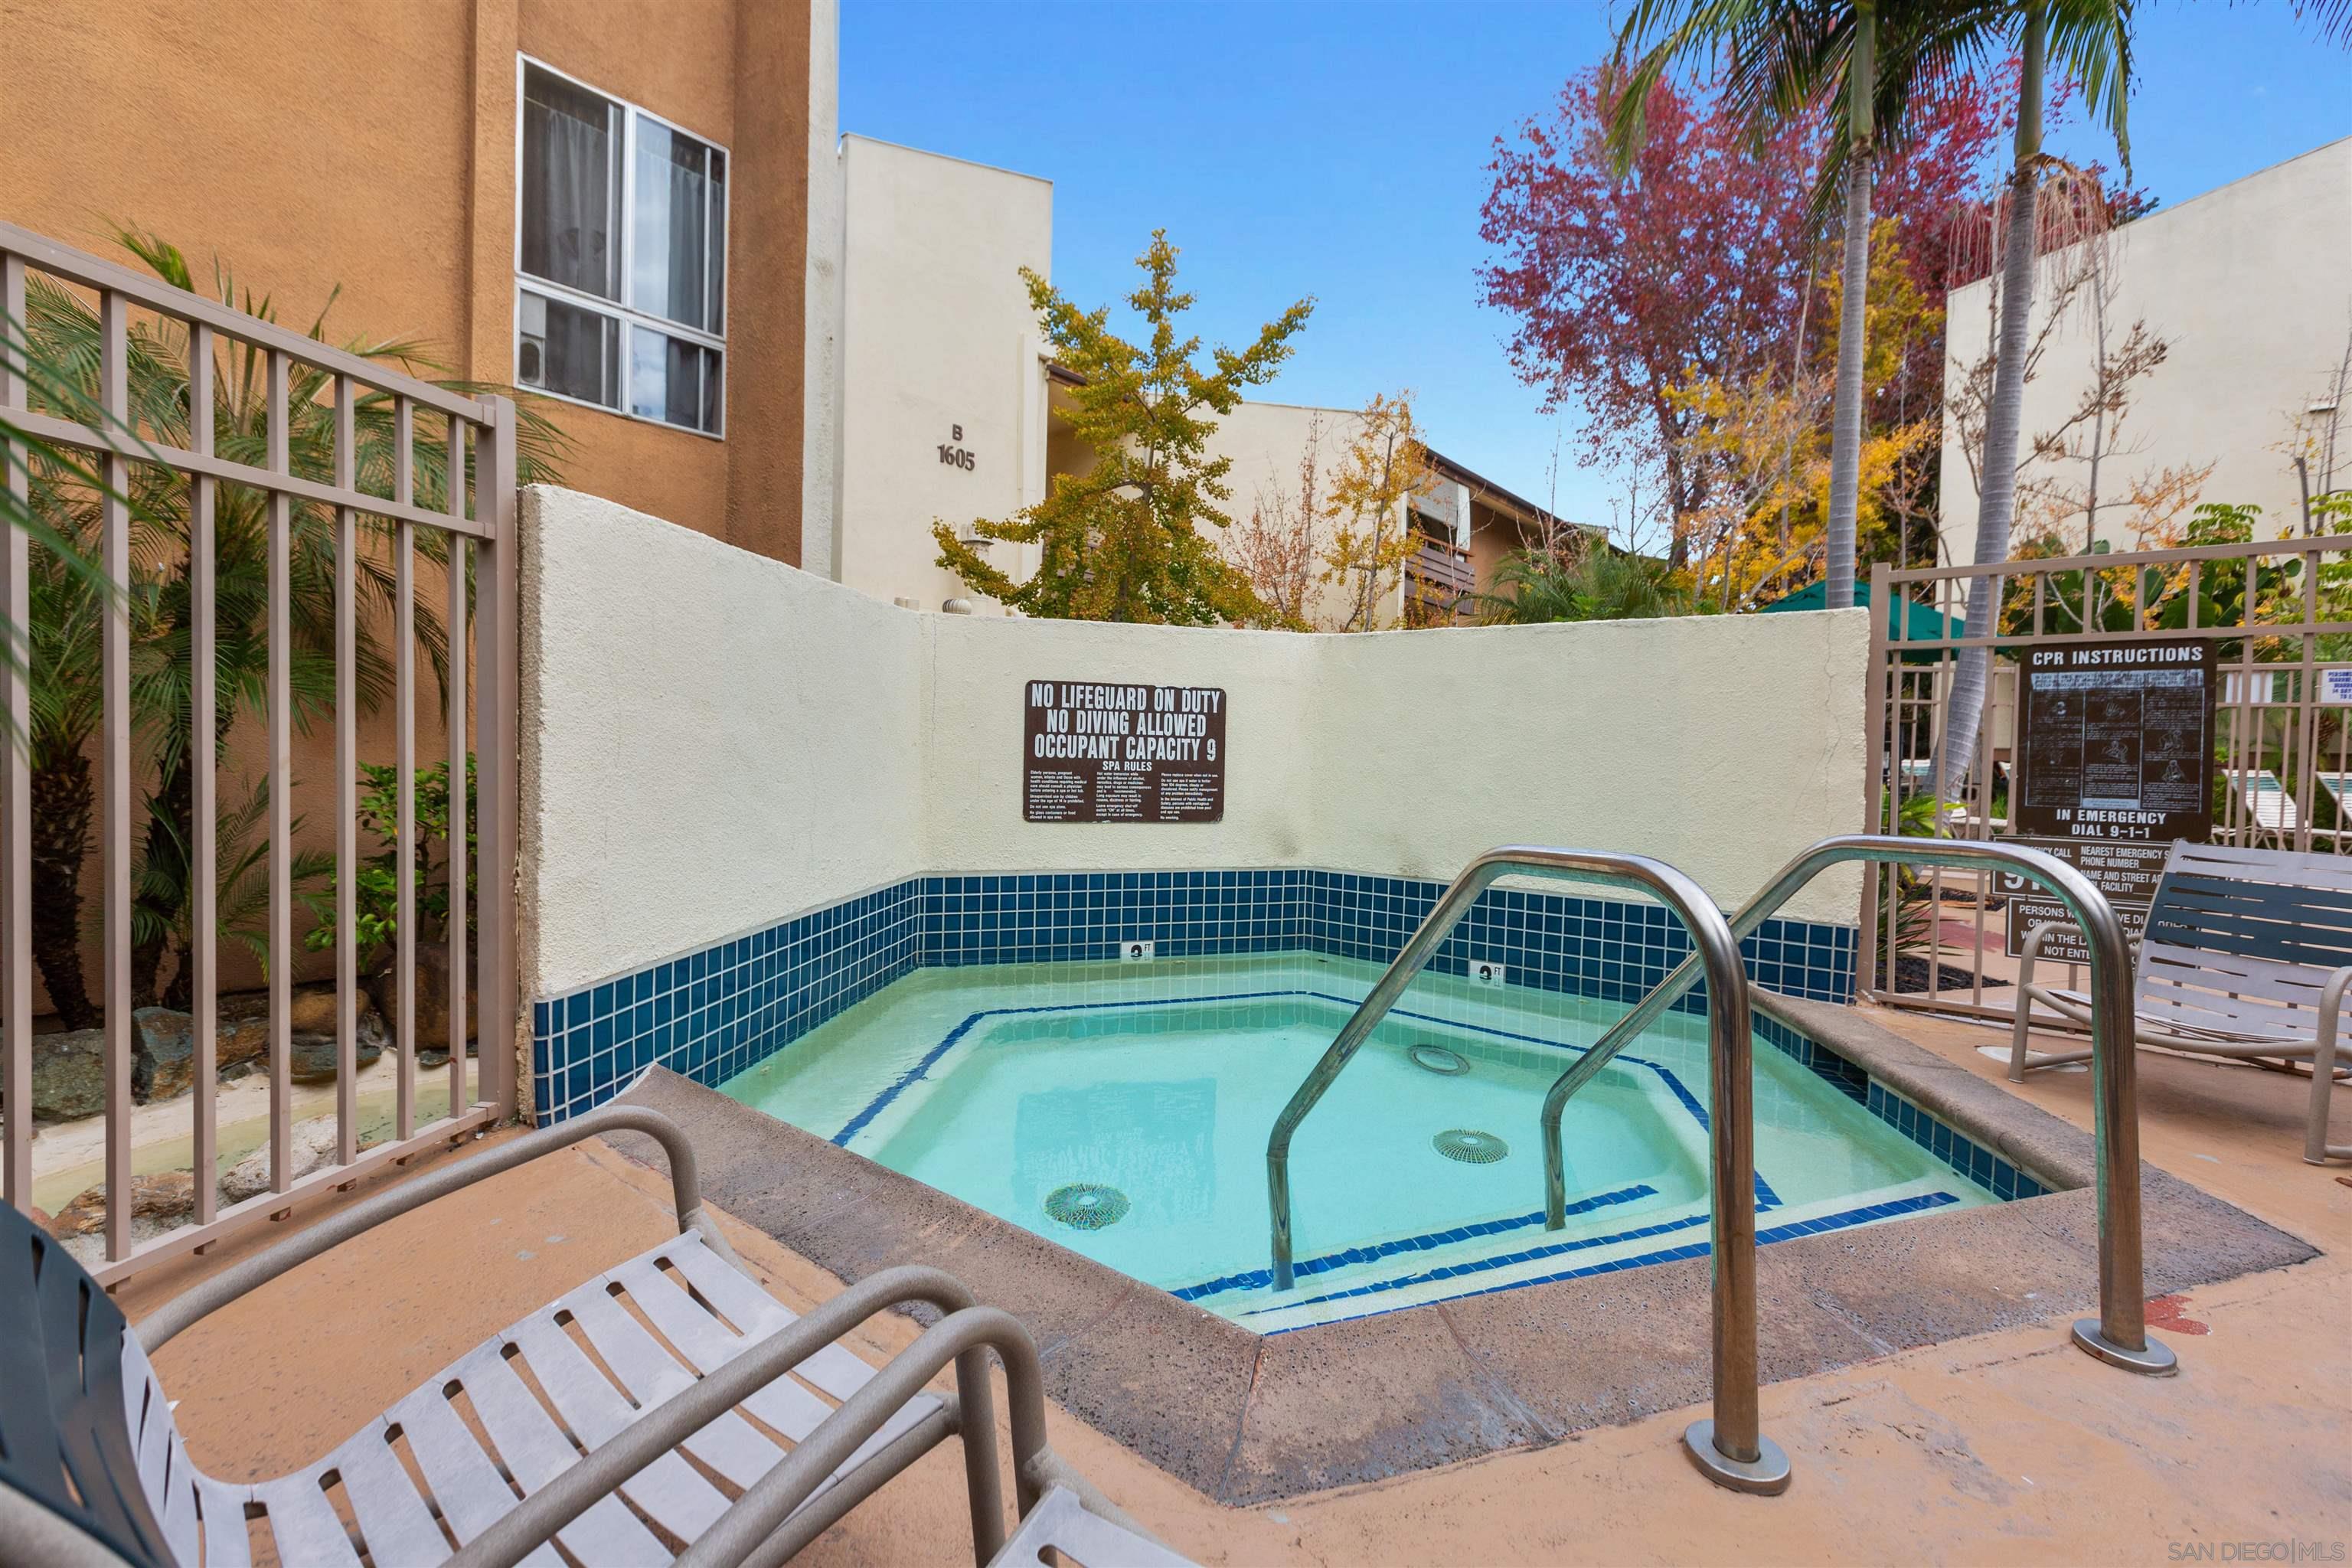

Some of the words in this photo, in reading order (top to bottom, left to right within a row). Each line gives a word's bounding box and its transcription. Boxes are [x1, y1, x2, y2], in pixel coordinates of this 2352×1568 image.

[952, 424, 963, 441] B
[937, 443, 975, 471] 1605
[2033, 652, 2064, 665] CPR
[2073, 646, 2203, 664] INSTRUCTIONS
[1031, 683, 1054, 707] NO
[1062, 684, 1147, 710] LIFEGUARD
[1154, 688, 1174, 712] ON
[1181, 690, 1220, 714] DUTY
[1047, 709, 1069, 733] NO
[1076, 710, 1129, 735] DIVING
[1136, 713, 1207, 737] ALLOWED
[1034, 733, 1120, 760] OCCUPANT
[1125, 737, 1200, 761] CAPACITY
[1207, 738, 1216, 762] 9
[1102, 761, 1120, 771] SPA
[1124, 761, 1152, 772] RULES
[2056, 808, 2070, 821] IN
[2078, 810, 2166, 825] EMERGENCY
[2072, 825, 2103, 836] DIAL
[2110, 825, 2150, 839] 9-1-1
[2054, 848, 2072, 858] CALL
[2081, 846, 2114, 856] NEAREST
[2116, 848, 2162, 859] EMERGENCY
[2081, 856, 2105, 867] PHONE
[2107, 858, 2139, 868] NUMBER
[2080, 870, 2102, 880] NAME
[2103, 872, 2119, 881] AND
[2122, 873, 2150, 883] STREET
[2101, 882, 2134, 893] FACILITY
[2019, 905, 2065, 917] PERSONS
[2057, 934, 2076, 944] THE
[2044, 946, 2065, 956] NOT
[1494, 967, 1501, 975] FT
